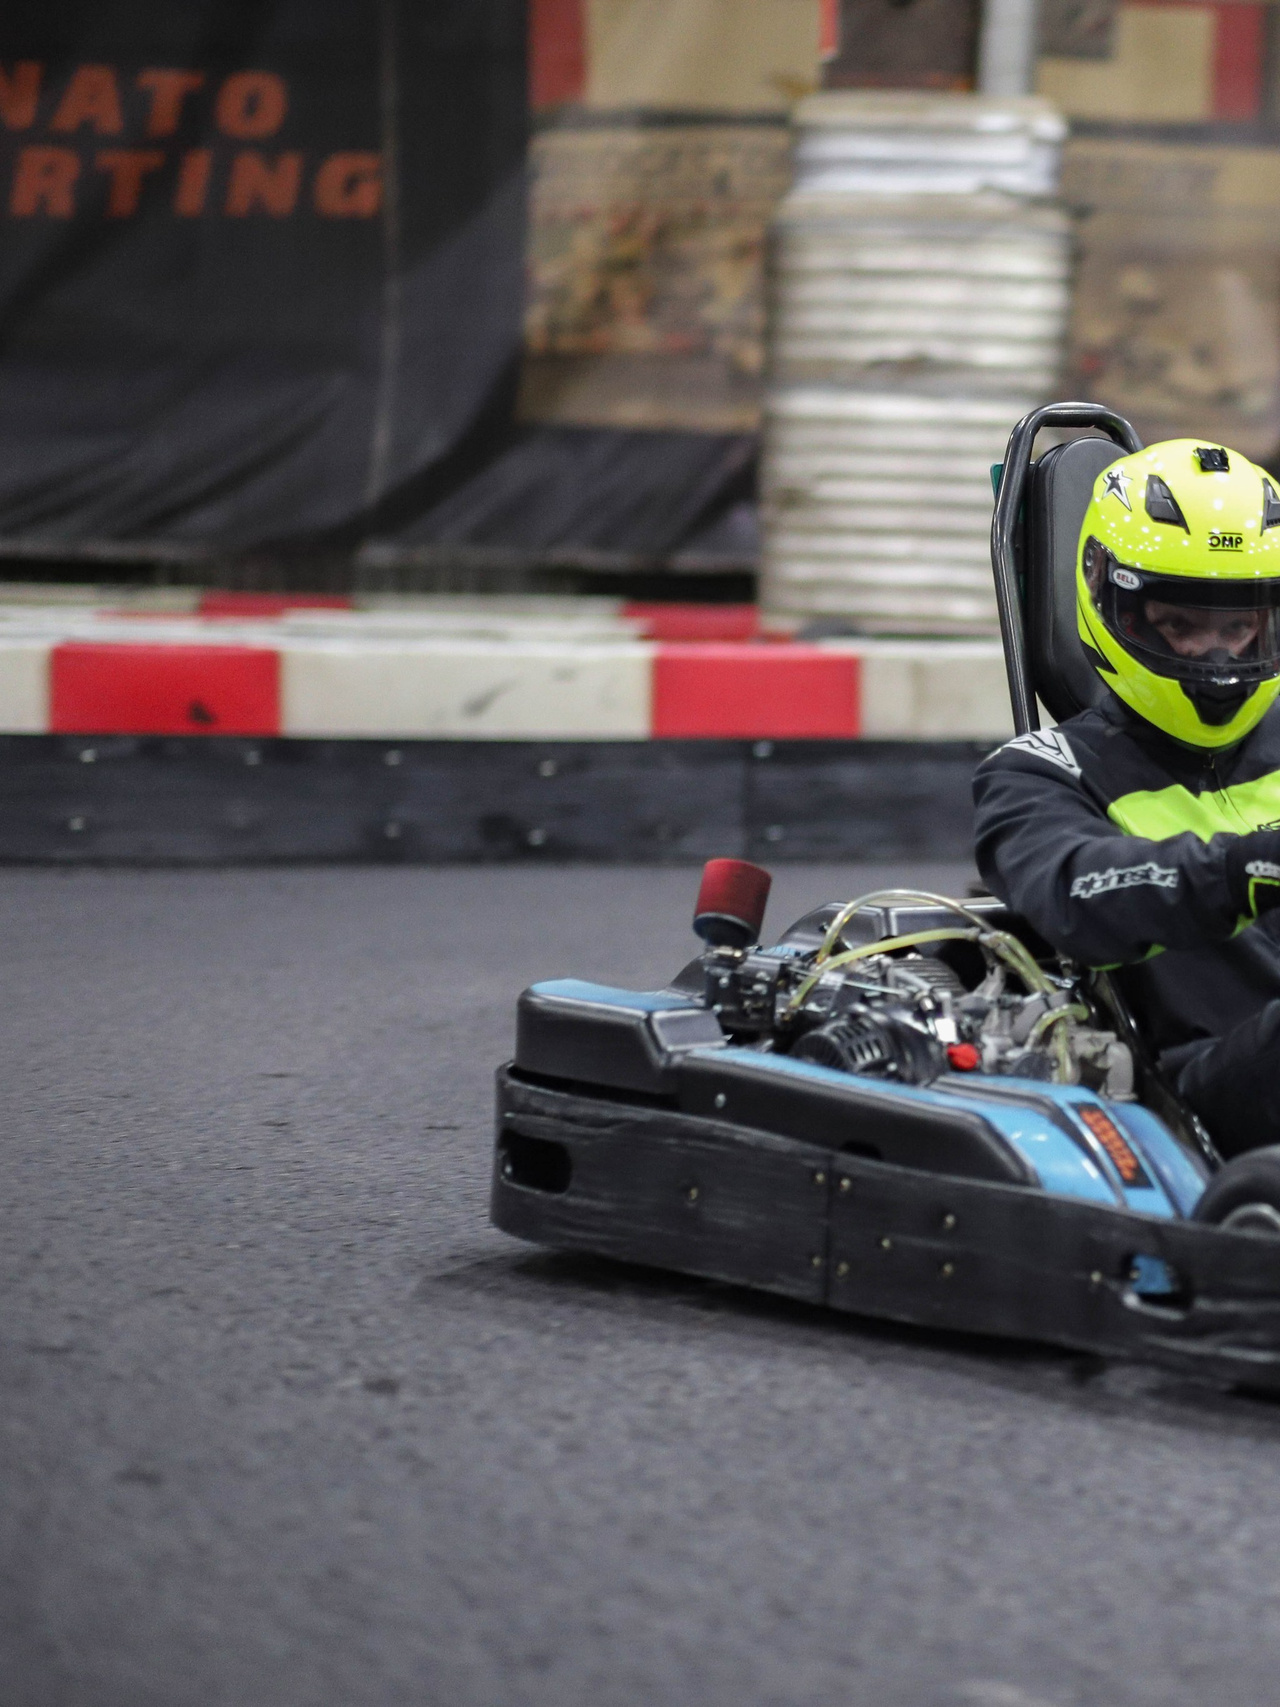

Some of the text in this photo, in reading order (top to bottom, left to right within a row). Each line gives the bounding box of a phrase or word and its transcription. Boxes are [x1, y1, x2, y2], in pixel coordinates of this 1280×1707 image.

[12, 147, 384, 217] RTING
[1208, 535, 1243, 548] OMP
[1116, 572, 1135, 585] BELL
